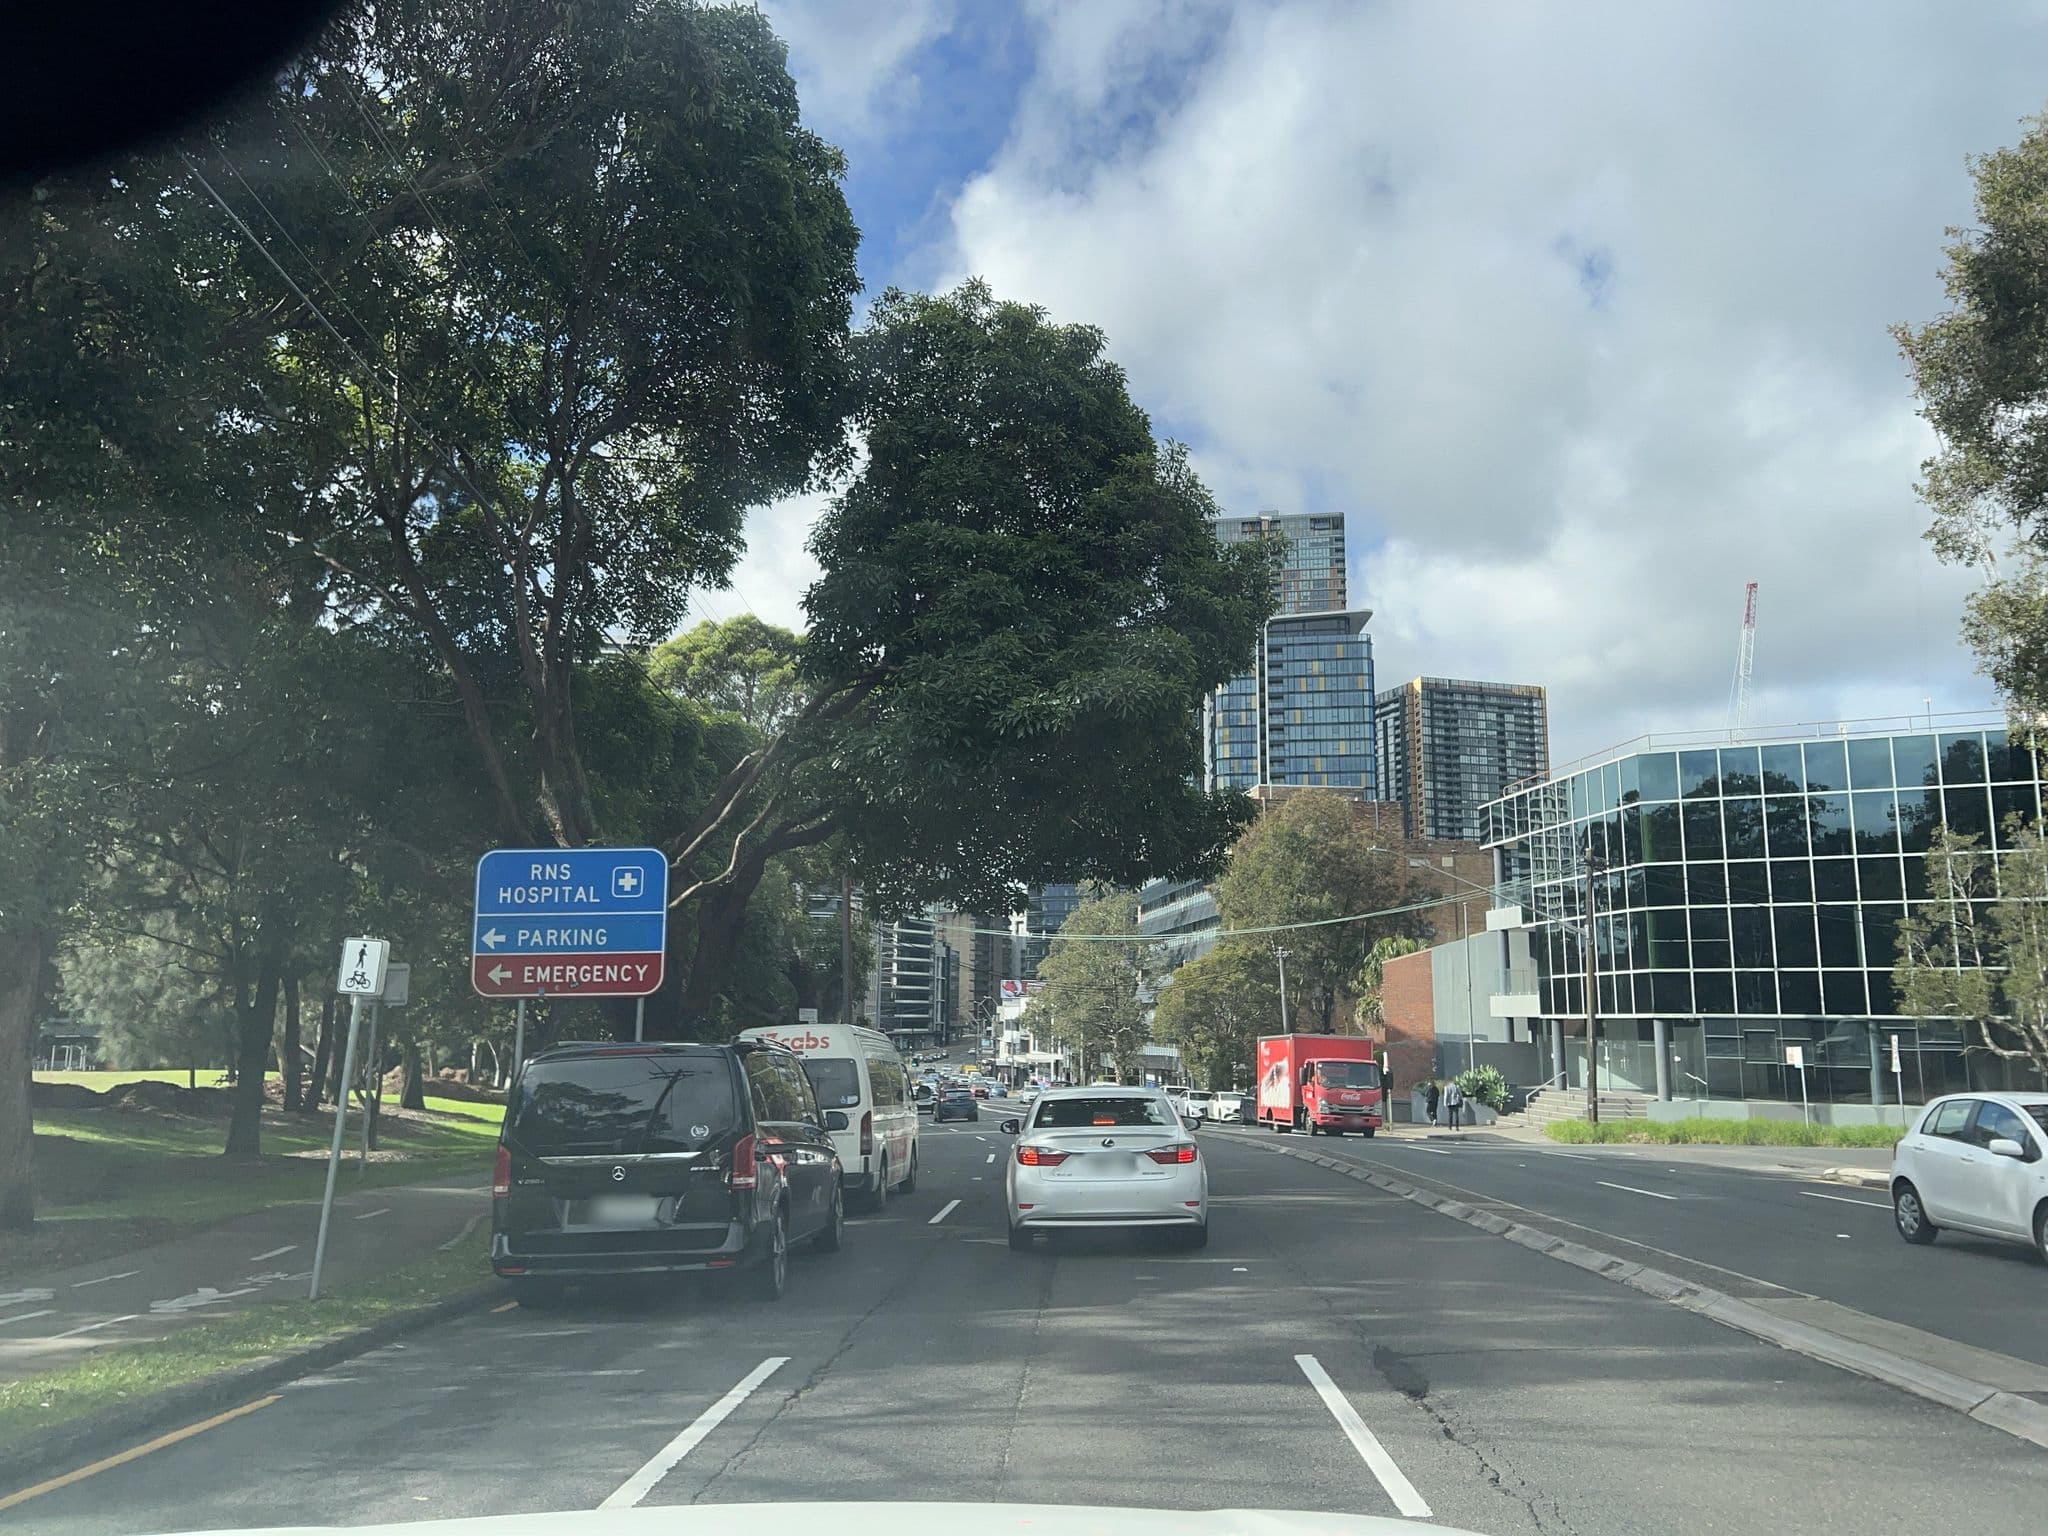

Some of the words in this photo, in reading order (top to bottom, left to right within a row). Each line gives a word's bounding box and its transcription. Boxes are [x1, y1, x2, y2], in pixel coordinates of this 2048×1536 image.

[531, 864, 571, 880] RNS
[498, 886, 601, 904] HOSPITAL
[518, 928, 608, 947] PARKING
[523, 964, 649, 983] EMERGENCY
